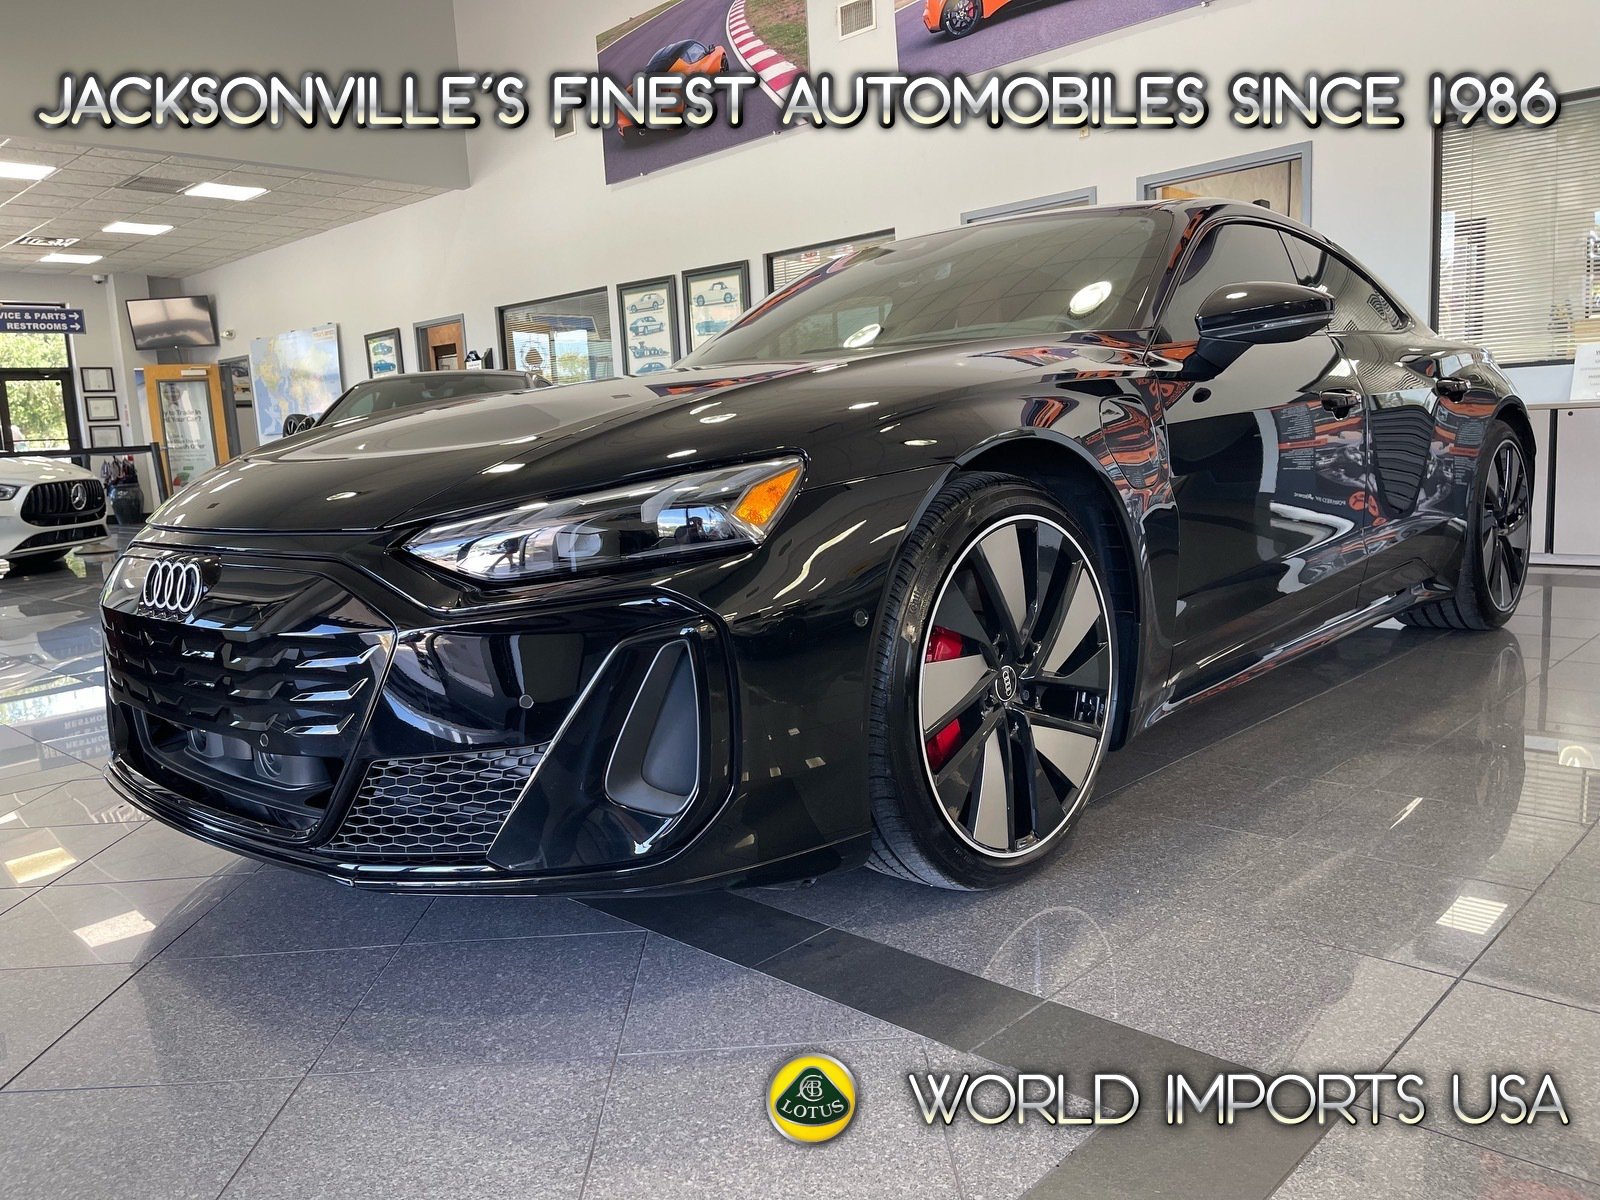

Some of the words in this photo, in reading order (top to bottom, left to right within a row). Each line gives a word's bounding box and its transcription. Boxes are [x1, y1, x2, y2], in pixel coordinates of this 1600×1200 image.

[24, 312, 31, 320] &
[34, 312, 67, 320] PARTS
[7, 322, 68, 331] RESTROOMS
